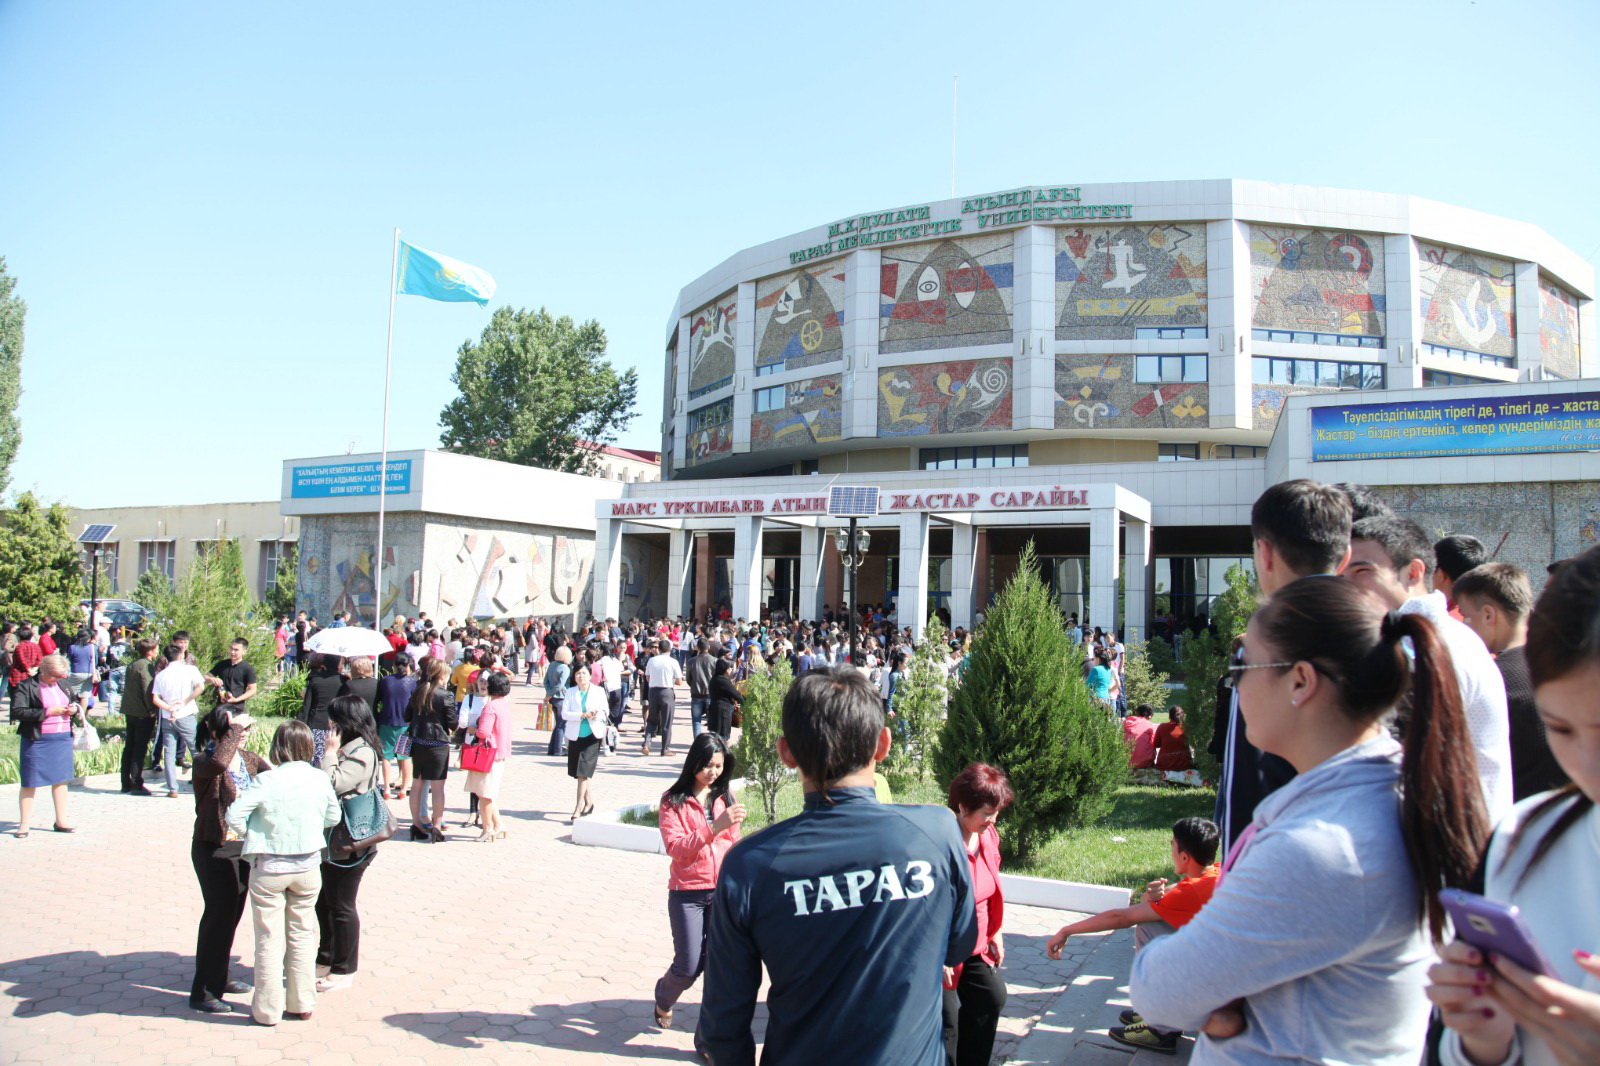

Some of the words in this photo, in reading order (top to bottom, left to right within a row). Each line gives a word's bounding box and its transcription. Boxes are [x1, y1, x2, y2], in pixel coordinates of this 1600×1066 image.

[961, 187, 1081, 213] АТЫНДАҒЫ
[789, 242, 832, 264] ТАРАЗ
[838, 218, 962, 251] МЕМЛЕКЕТТІК
[977, 204, 1132, 228] УНИВЕРСИТЕТІ
[1342, 406, 1442, 426] Тәуелсіздігіміздің
[1444, 404, 1476, 421] тірегі
[1478, 405, 1496, 419] де,
[1499, 401, 1531, 417] тілегі
[1534, 402, 1549, 416] де
[1315, 429, 1356, 443] Жастар
[1367, 426, 1400, 440] біздің
[1462, 423, 1495, 437] келер
[1498, 416, 1582, 436] күндеріміздің
[611, 502, 656, 516] МАРС
[663, 499, 764, 515] ҮРКІМБАЕВ
[890, 493, 980, 510] ЖАСТАР
[990, 485, 1088, 508] САРАЙЫ
[784, 860, 935, 917] ТАРАЗ
